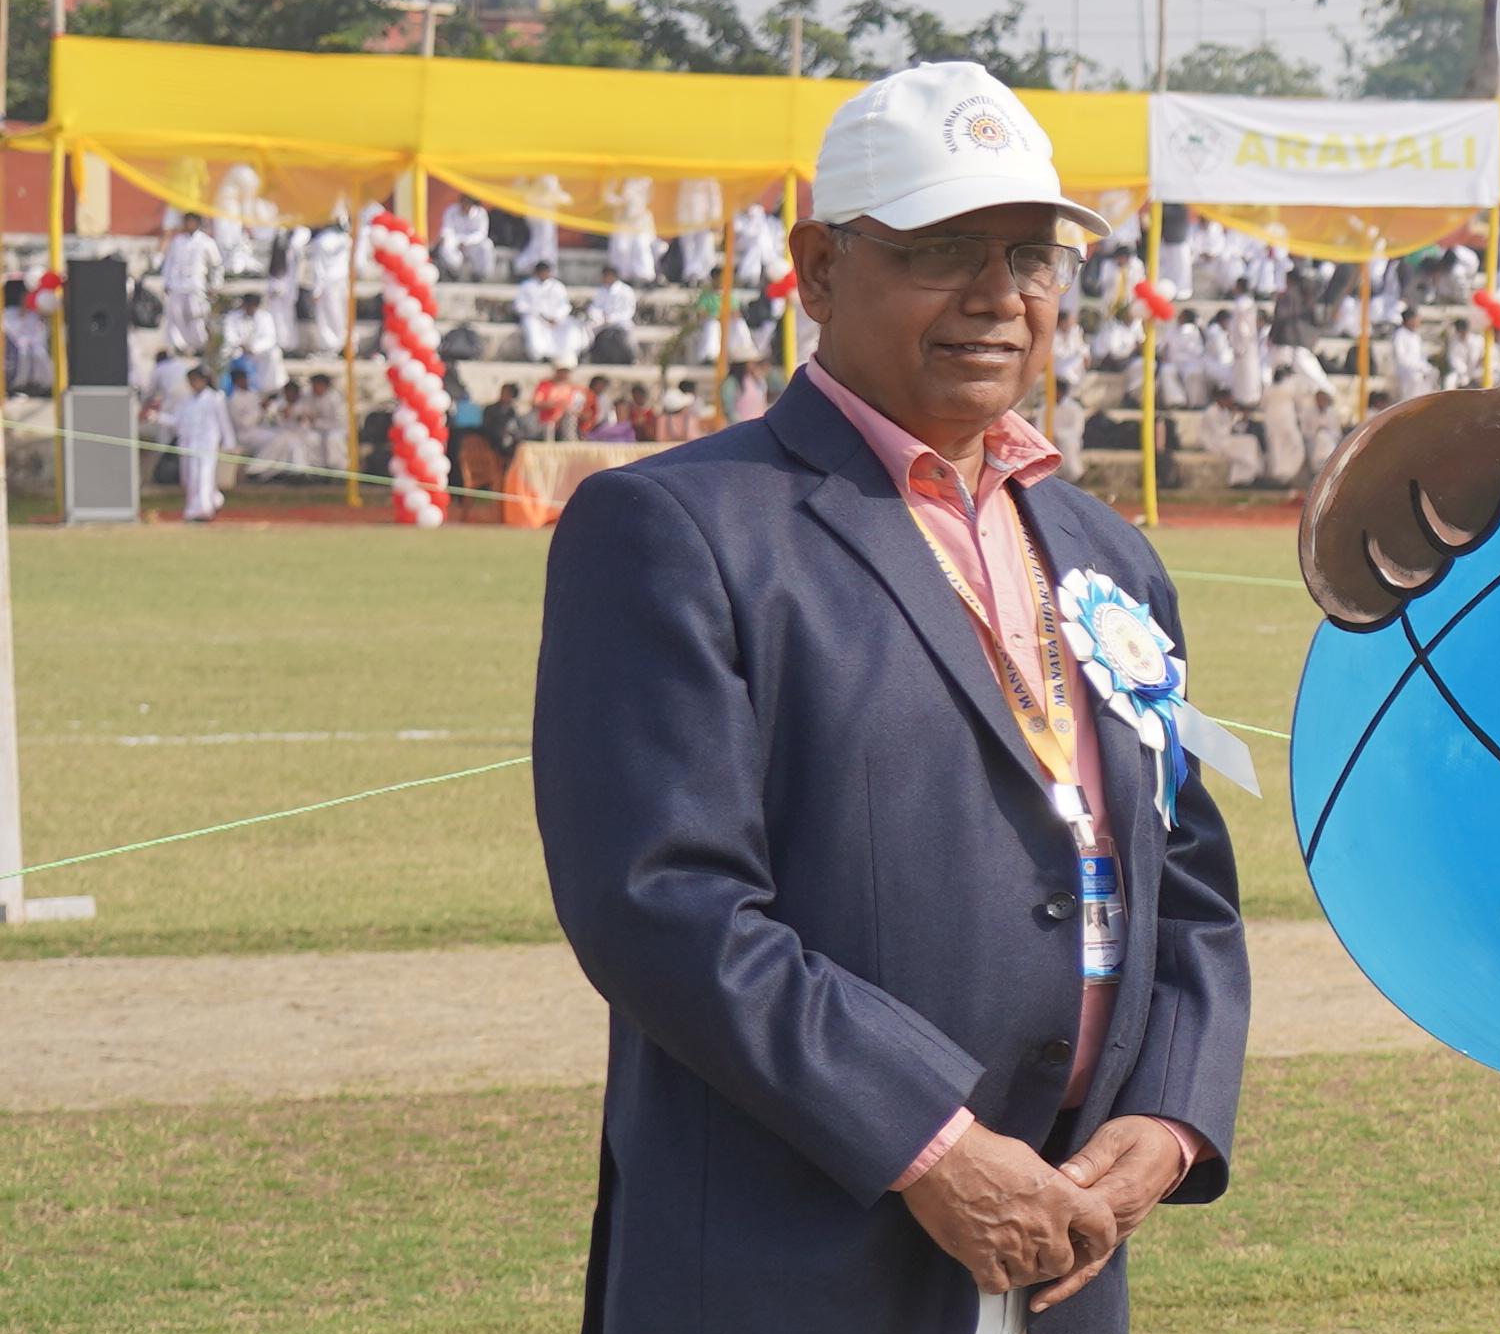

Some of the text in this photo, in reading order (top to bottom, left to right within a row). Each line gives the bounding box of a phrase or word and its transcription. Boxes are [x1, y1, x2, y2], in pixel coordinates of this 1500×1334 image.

[1234, 129, 1477, 171] ARAVALI
[1034, 565, 1067, 707] MANAVA BHARATI
